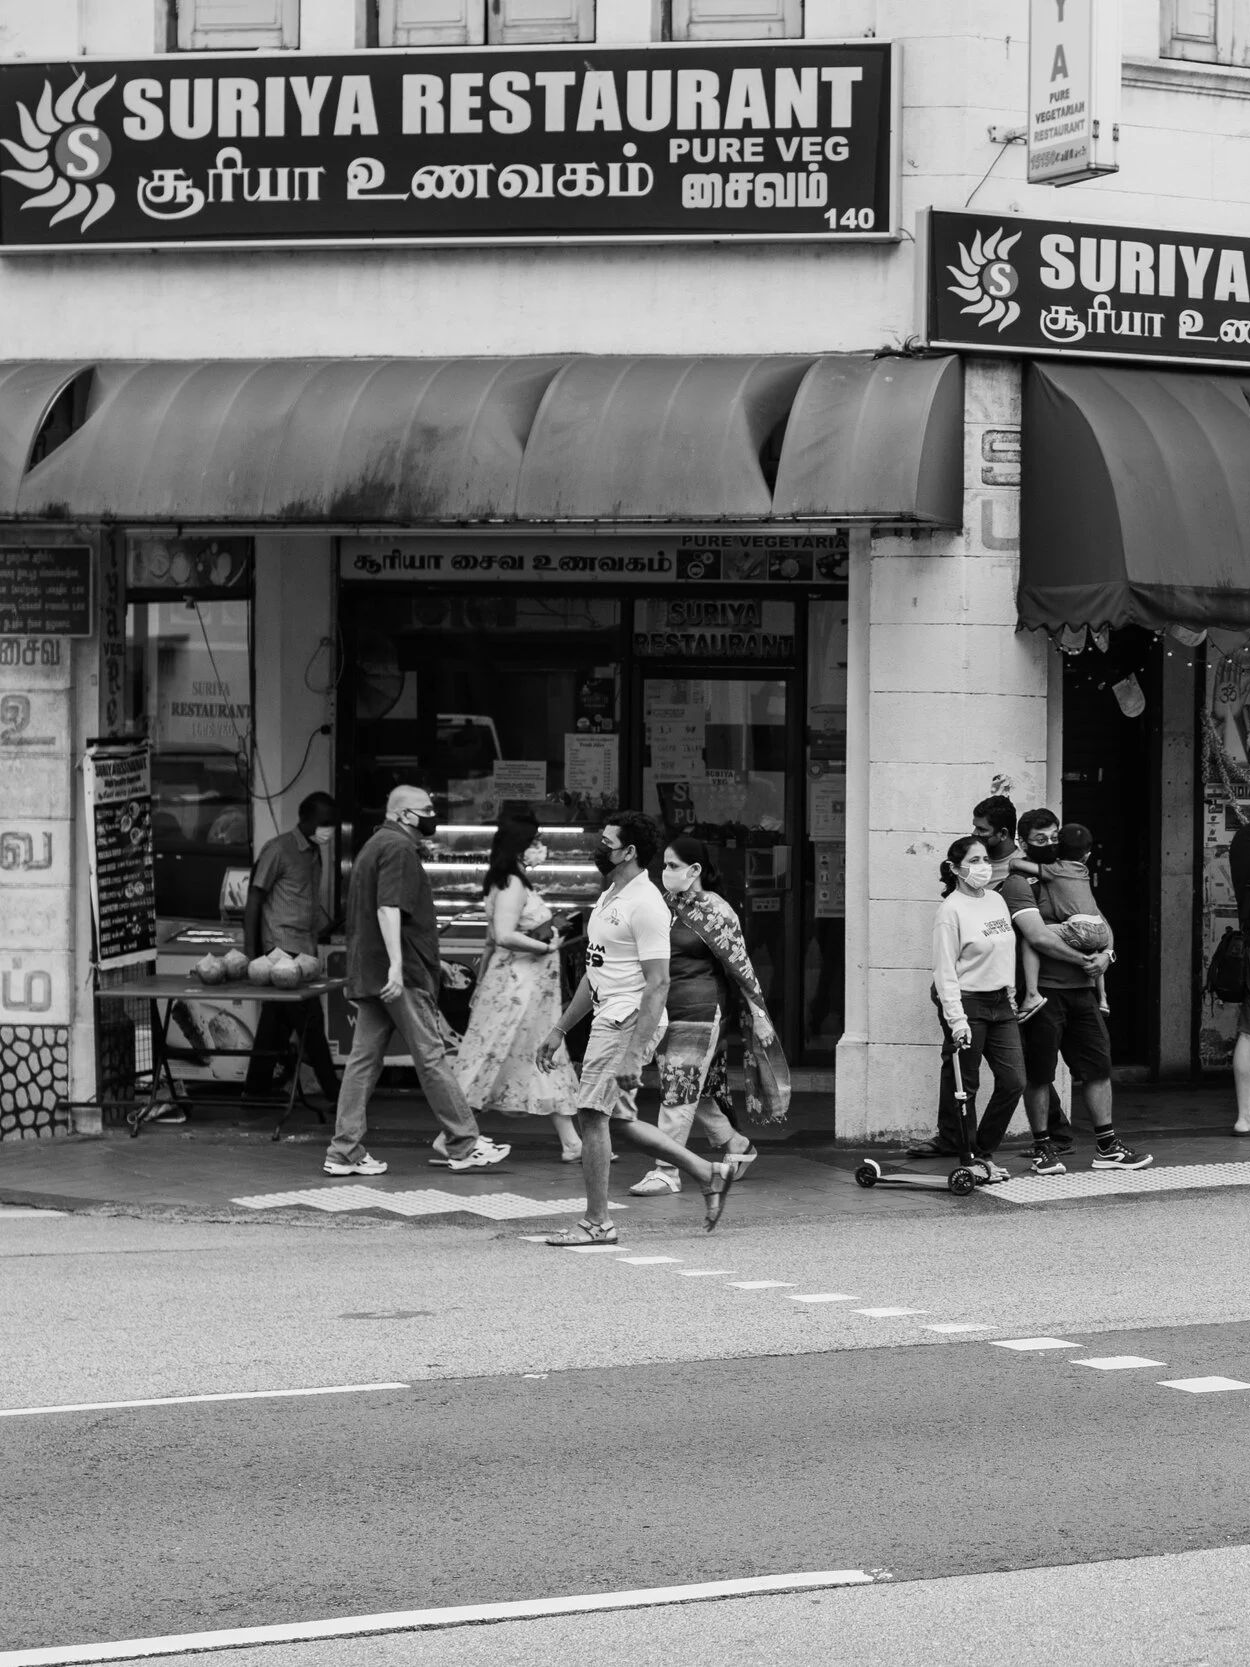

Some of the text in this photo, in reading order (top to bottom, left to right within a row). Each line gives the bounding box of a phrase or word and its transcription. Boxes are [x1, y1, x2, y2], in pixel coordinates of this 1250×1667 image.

[123, 67, 862, 139] SURIYA RESTAURANT
[1050, 88, 1069, 104] PURE
[1036, 101, 1084, 124] VEGETARIAN
[1034, 119, 1085, 143] RESTAURANT
[669, 136, 850, 163] PURE VEG
[137, 143, 654, 219] சூரியா உணவகம்
[682, 163, 828, 210] சைவம்
[824, 208, 876, 230] 140
[1040, 233, 1249, 302] SURIYA
[1040, 293, 1164, 343] சூரியா
[681, 535, 848, 549] PURE VEGETARIA
[353, 549, 444, 575] சூரியா
[532, 550, 673, 572] உணவகம்
[671, 602, 760, 626] SURIYA
[633, 633, 794, 658] RESTAURANT
[192, 680, 231, 697] SURIYA
[171, 702, 251, 719] RESTAURANT
